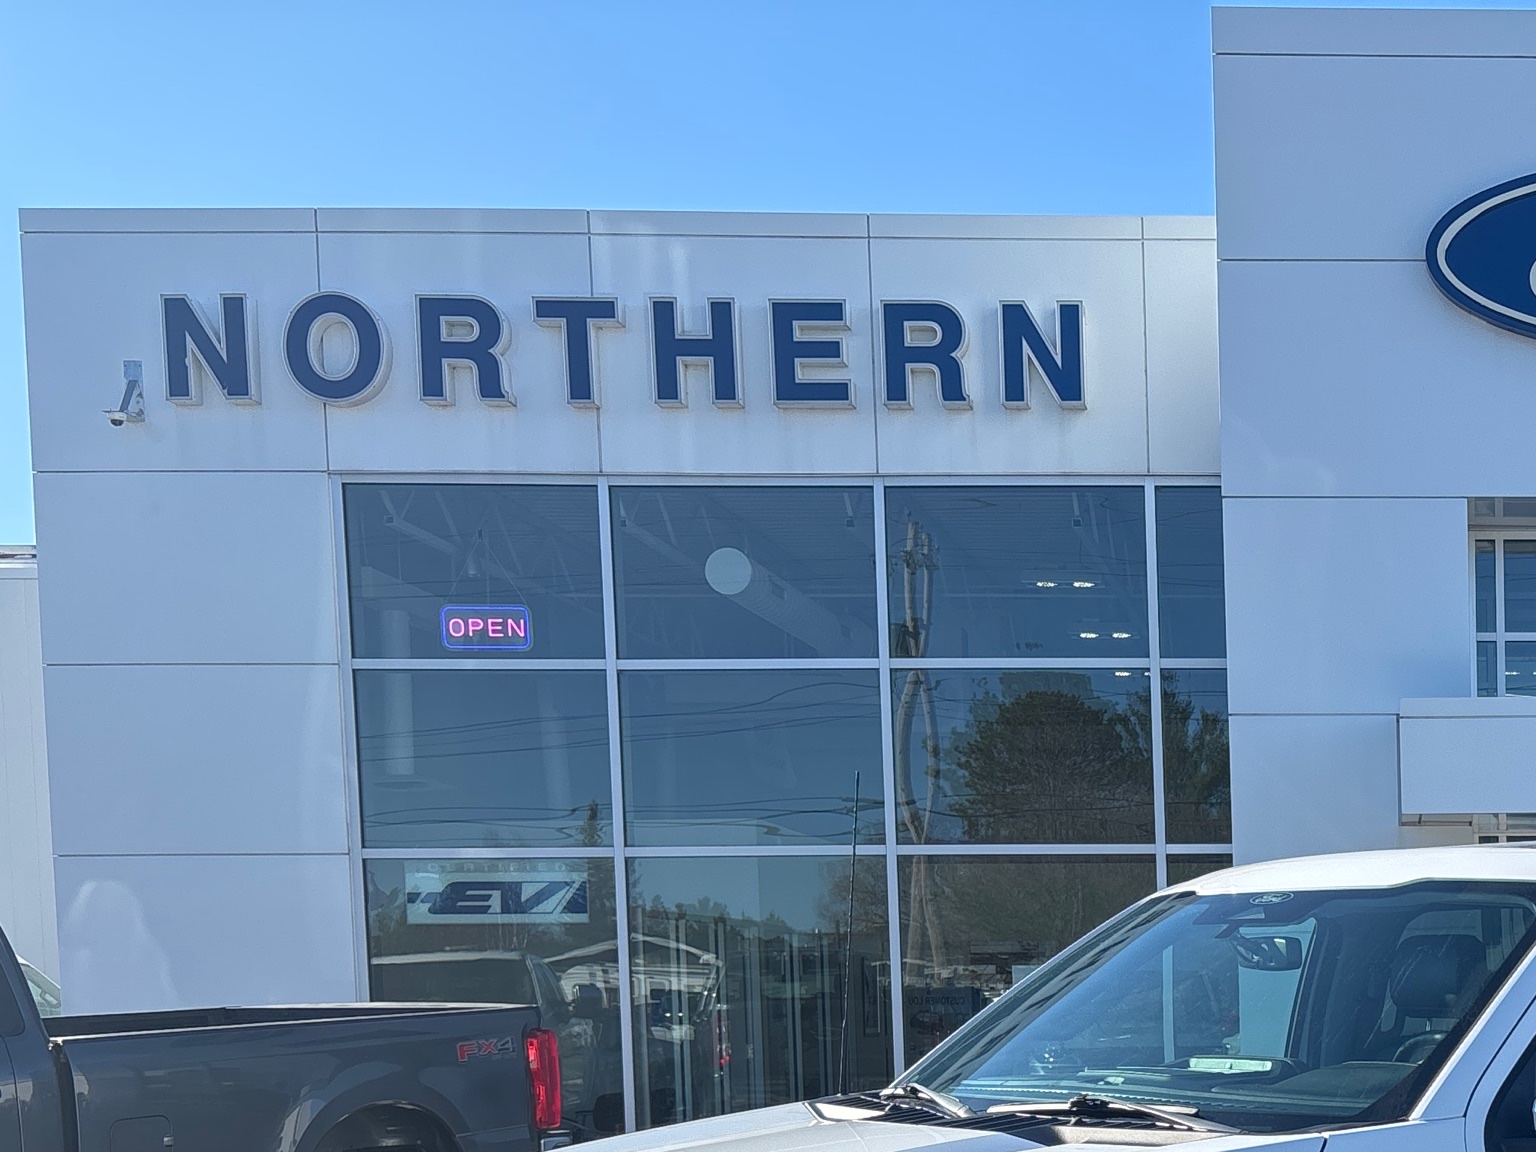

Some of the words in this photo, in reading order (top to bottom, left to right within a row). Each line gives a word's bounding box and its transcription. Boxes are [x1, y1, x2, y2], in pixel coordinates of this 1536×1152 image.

[160, 292, 1088, 408] NORTHERN
[448, 617, 525, 637] OPEN
[456, 1036, 517, 1064] FX4
